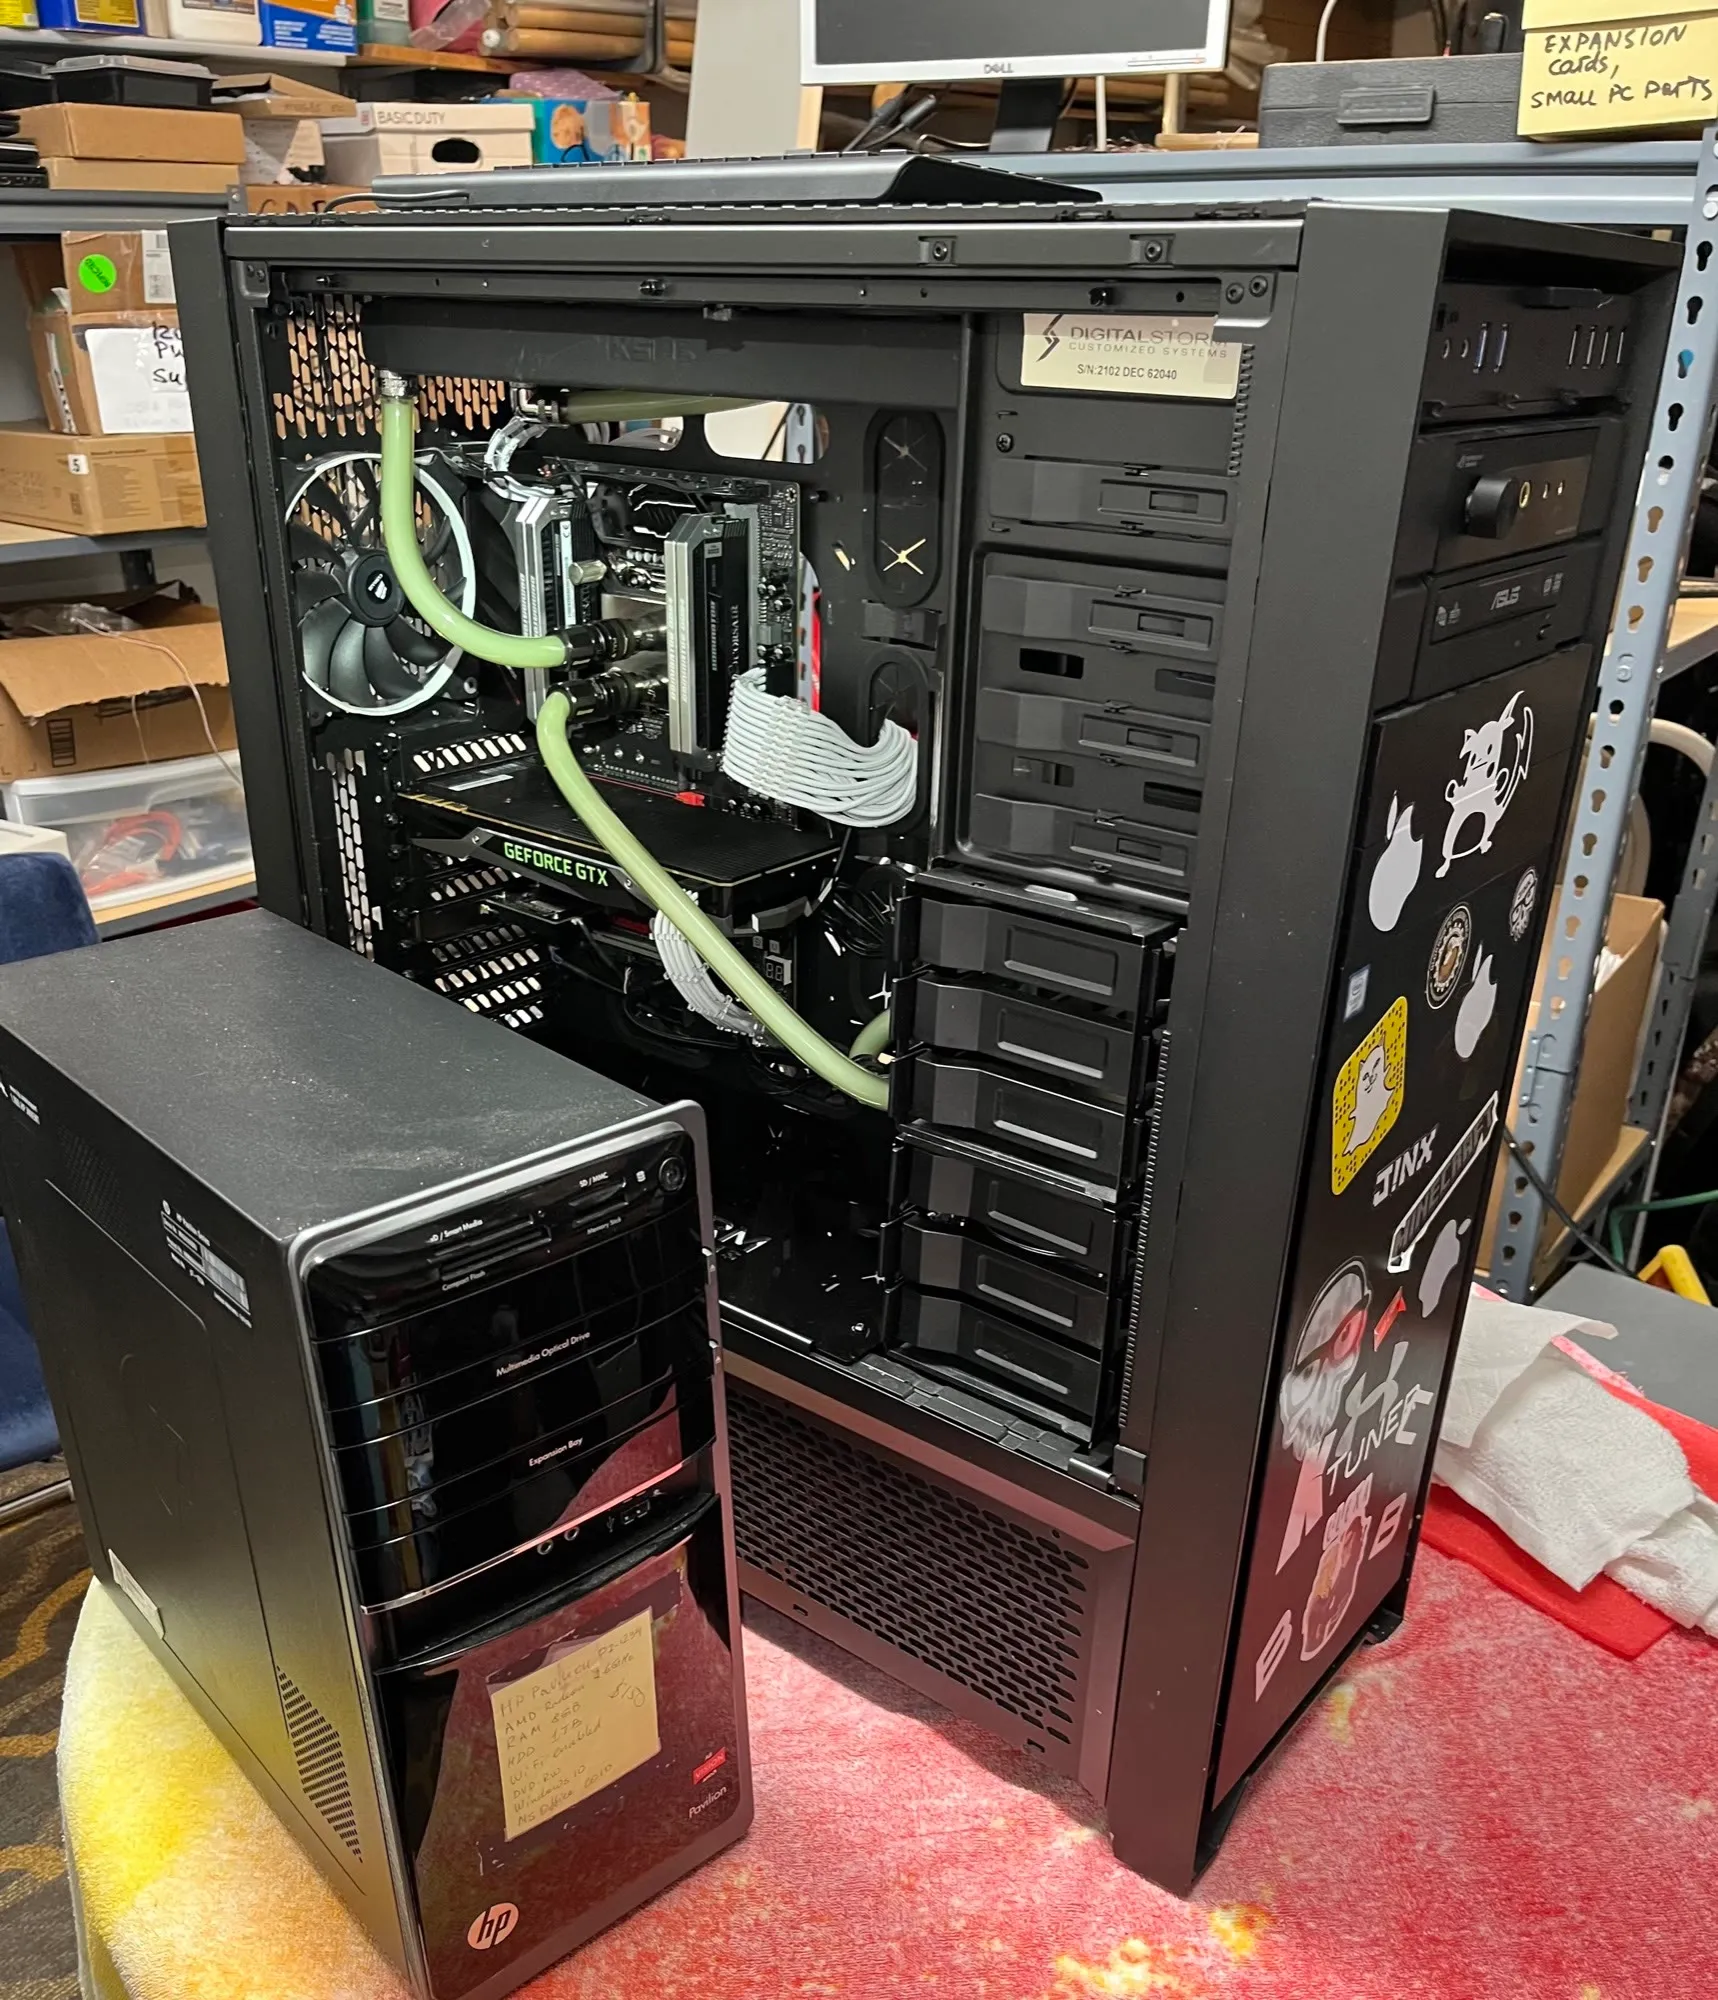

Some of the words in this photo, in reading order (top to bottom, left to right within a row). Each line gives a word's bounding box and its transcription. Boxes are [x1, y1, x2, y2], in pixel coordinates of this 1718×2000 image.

[1544, 24, 1687, 54] EXPANSION
[983, 62, 1015, 75] DELL
[1608, 84, 1634, 104] PC
[377, 110, 414, 125] BASIC
[415, 111, 446, 125] DUTY
[1069, 342, 1156, 355] CUSTOMIZED
[1162, 347, 1228, 359] SYSTEMS
[1077, 364, 1120, 377] S/N:2102
[1123, 366, 1145, 378] DEC
[1147, 368, 1177, 380] 62040
[503, 841, 573, 876] GEFORCE
[575, 862, 609, 887] GTX
[496, 1353, 541, 1377] Multimedia
[541, 1338, 570, 1357] Optical
[570, 1332, 591, 1345] Drive
[529, 1445, 568, 1467] Expansion
[568, 1437, 583, 1449] Bay
[500, 1695, 525, 1718] HP
[505, 1711, 537, 1735] AMD
[506, 1726, 542, 1750] RAM
[507, 1746, 536, 1769] HDD
[689, 1786, 727, 1819] Pavilion
[473, 1904, 514, 1949] hp
